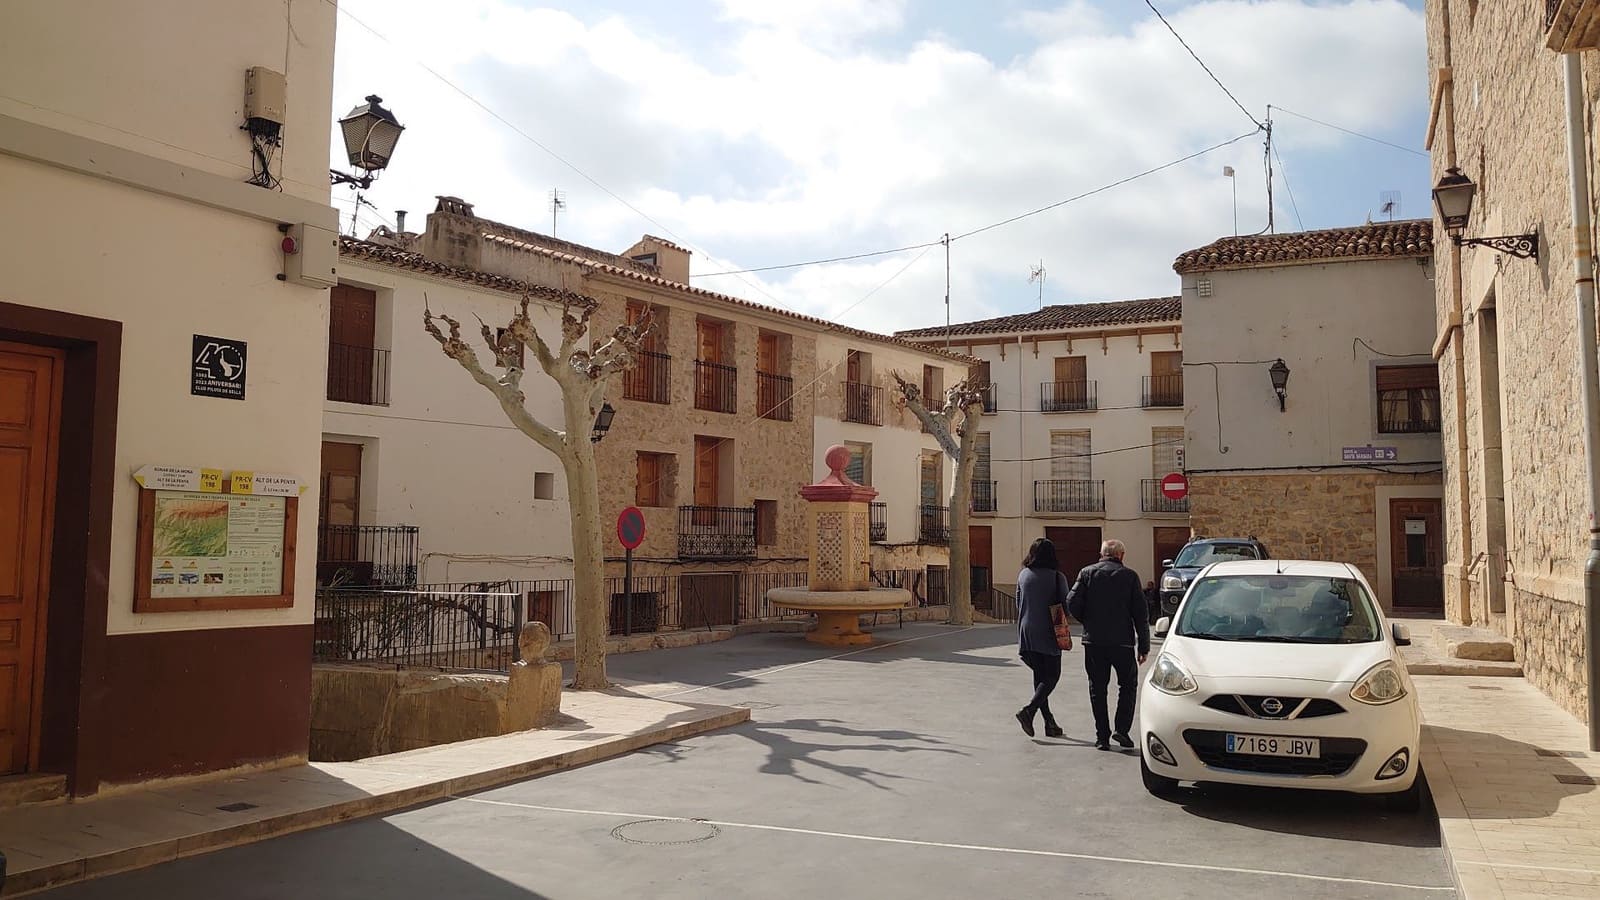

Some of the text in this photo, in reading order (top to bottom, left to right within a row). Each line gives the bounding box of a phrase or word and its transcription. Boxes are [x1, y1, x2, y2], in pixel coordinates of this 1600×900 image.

[207, 380, 241, 389] ANIVERSARI
[201, 473, 218, 481] PR-CV
[1237, 737, 1313, 755] 7169 JBV
